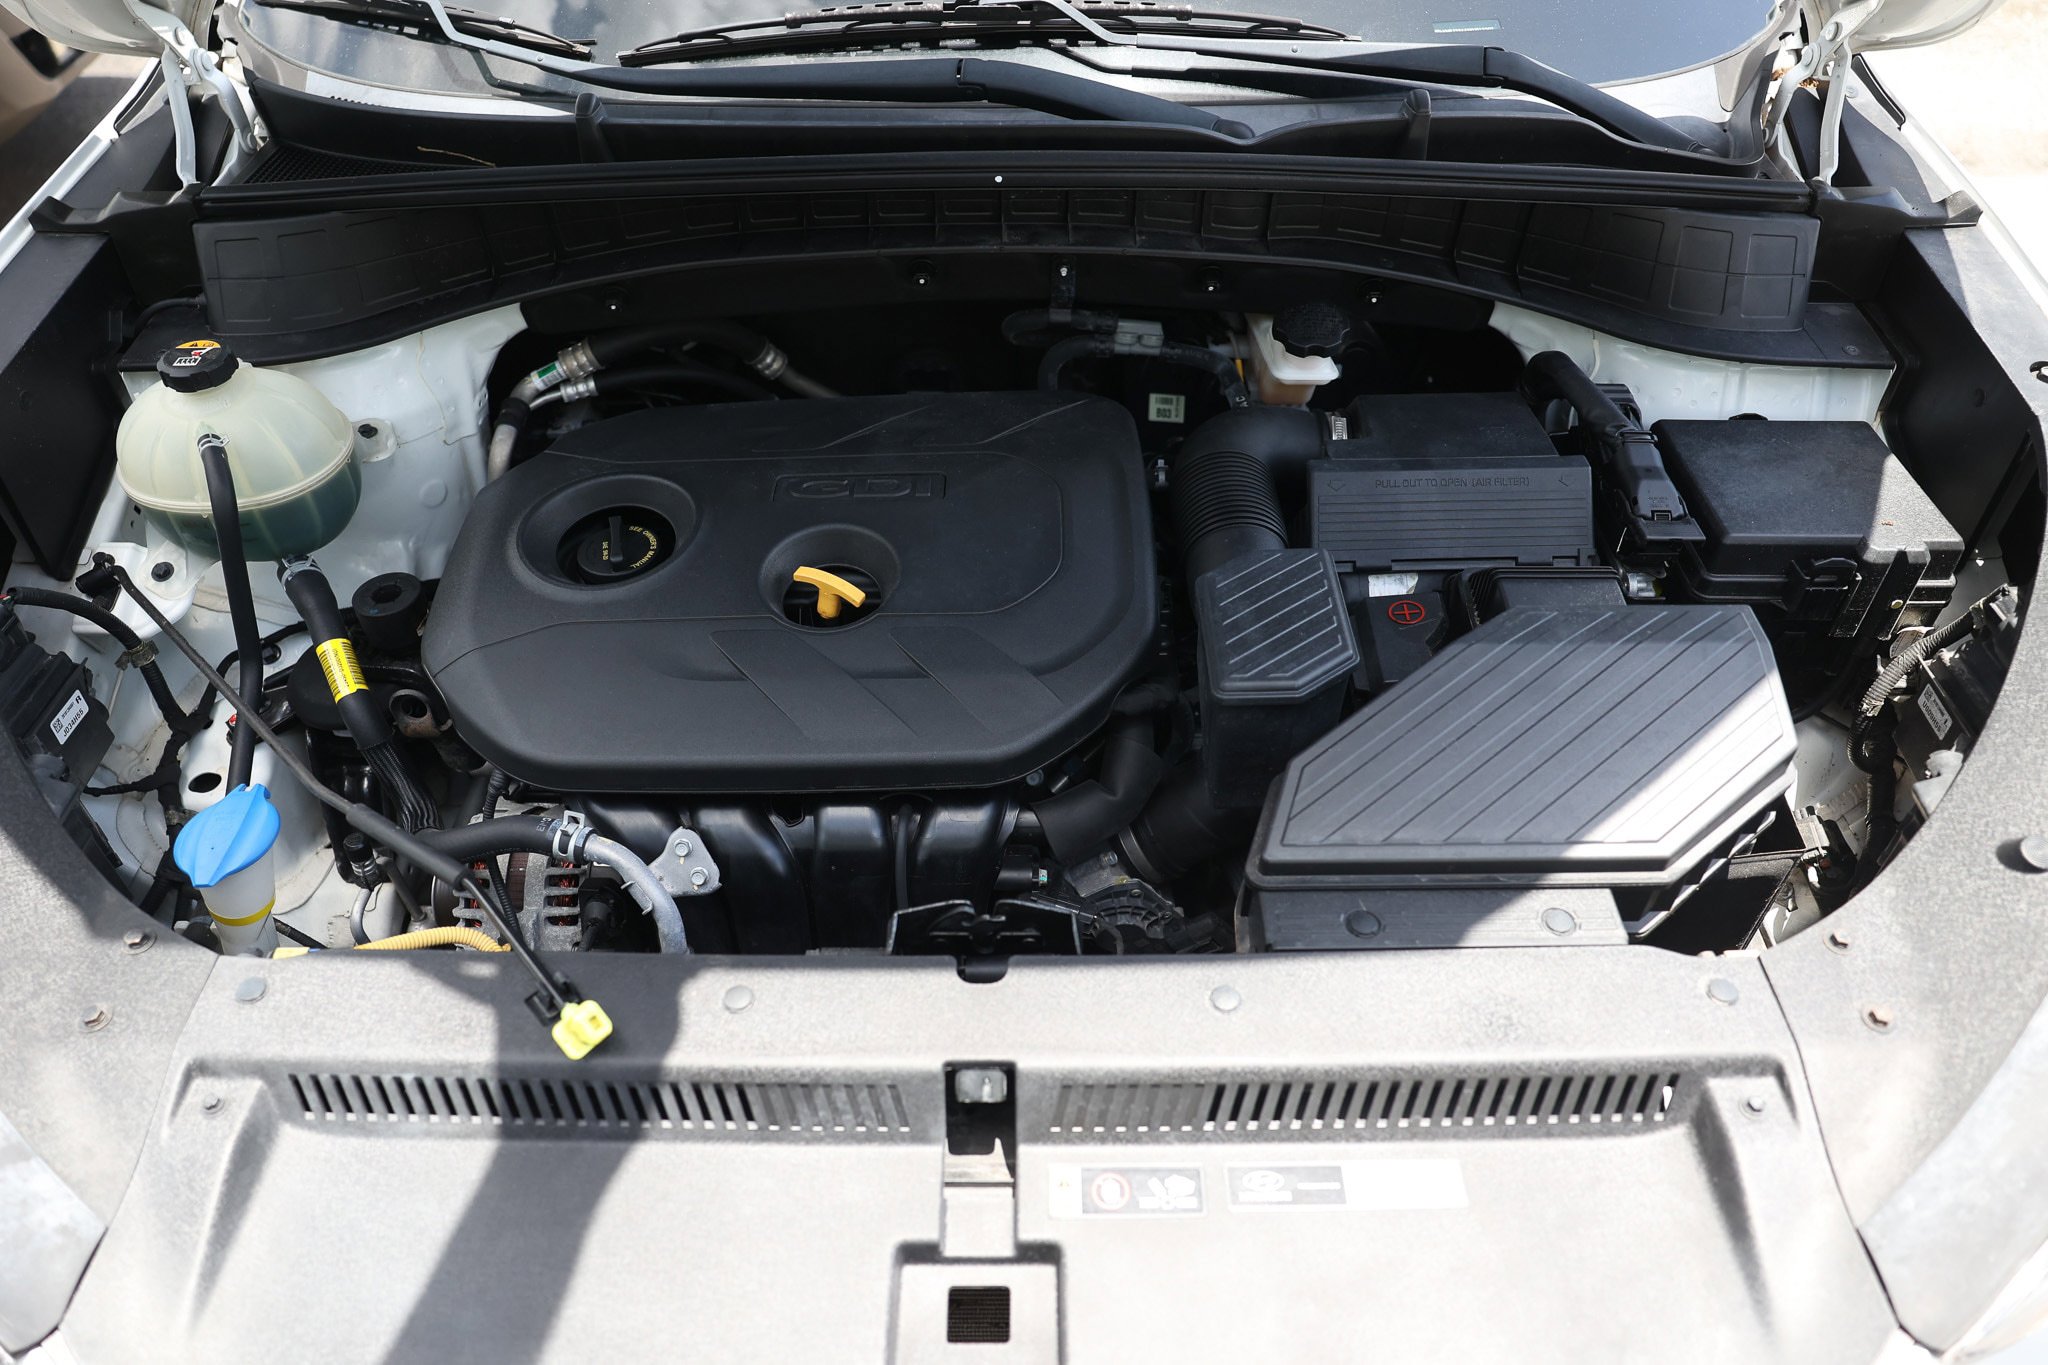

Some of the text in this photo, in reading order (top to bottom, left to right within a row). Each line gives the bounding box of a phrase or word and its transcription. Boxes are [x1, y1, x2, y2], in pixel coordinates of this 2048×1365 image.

[789, 479, 931, 497] GDI
[1375, 479, 1401, 489] PULL
[1402, 479, 1423, 488] OUT
[1424, 478, 1440, 488] TO
[1441, 478, 1467, 488] OPEN
[1494, 476, 1530, 487] FILTER)
[628, 525, 643, 533] SEE
[629, 550, 655, 569] MANUAL
